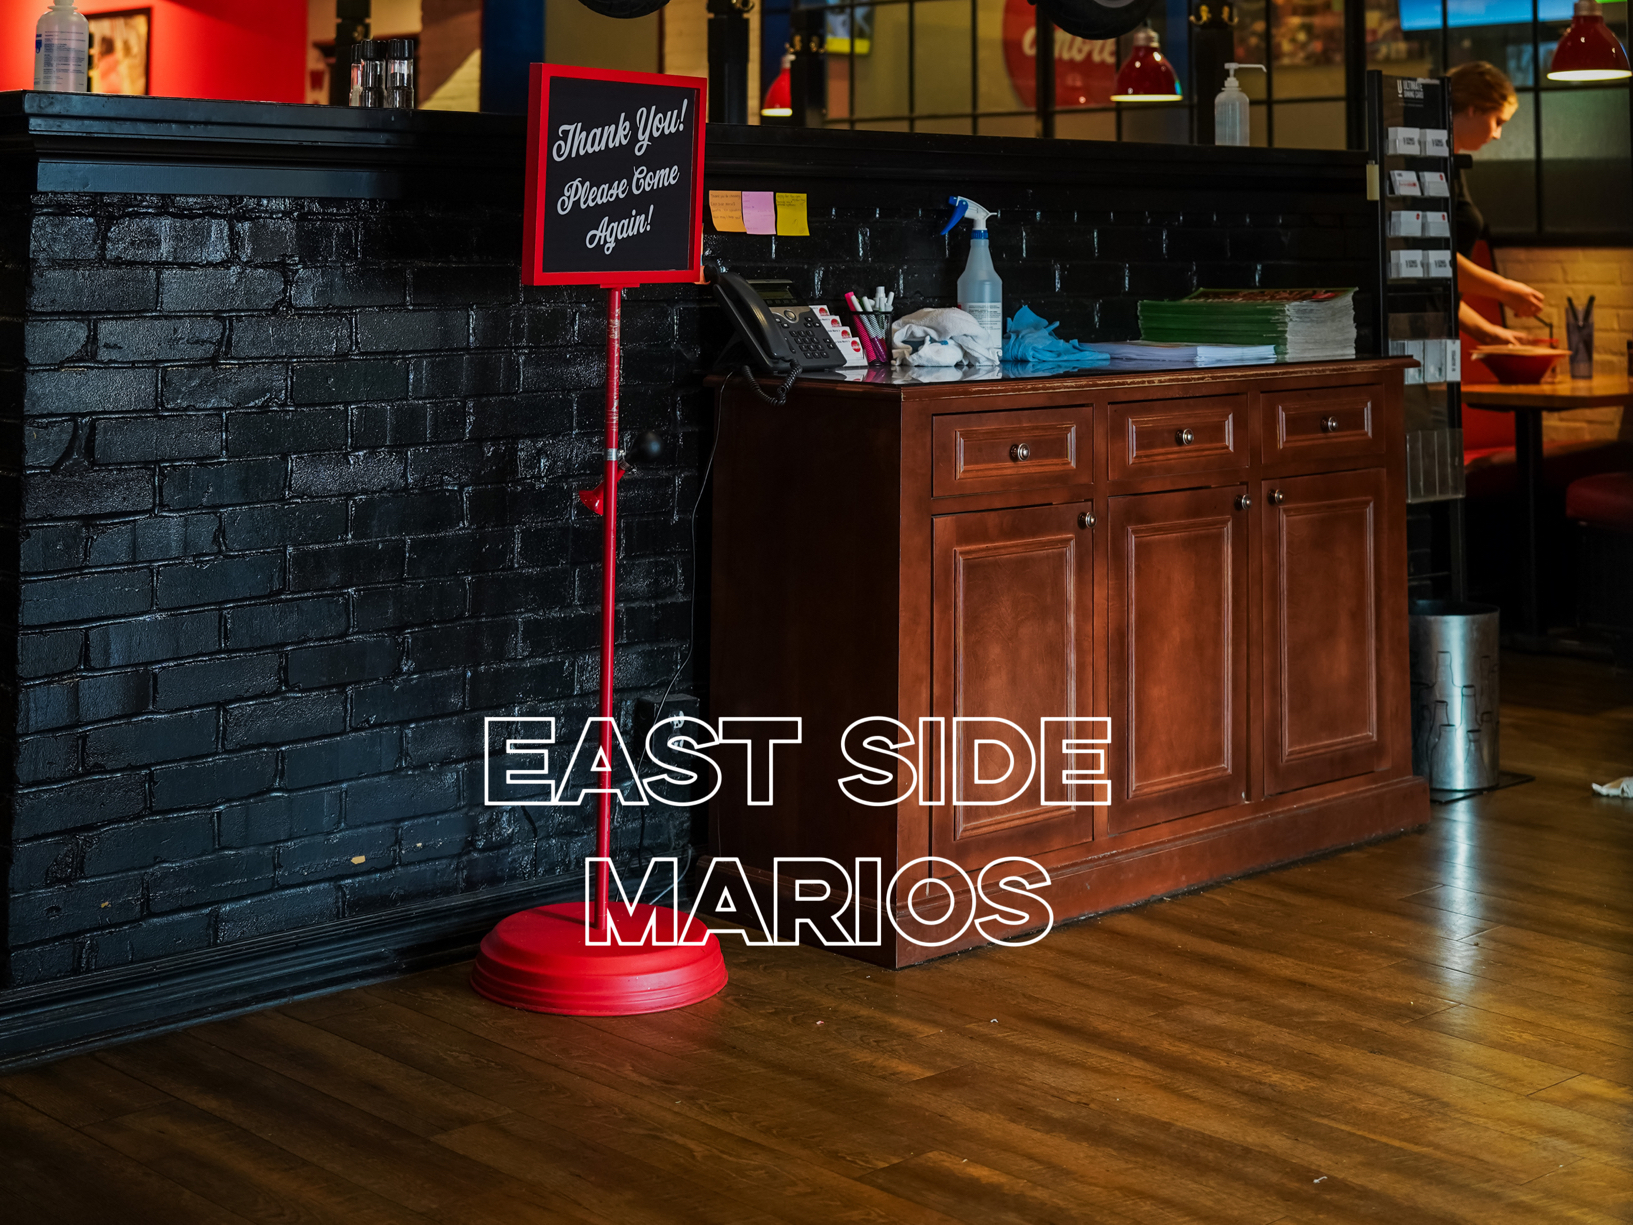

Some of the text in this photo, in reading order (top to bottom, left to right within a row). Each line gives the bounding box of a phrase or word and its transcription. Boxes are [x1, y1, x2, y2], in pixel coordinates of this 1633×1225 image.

[552, 98, 688, 162] Thank You!
[556, 165, 680, 215] Please Come
[585, 204, 655, 255] Again!
